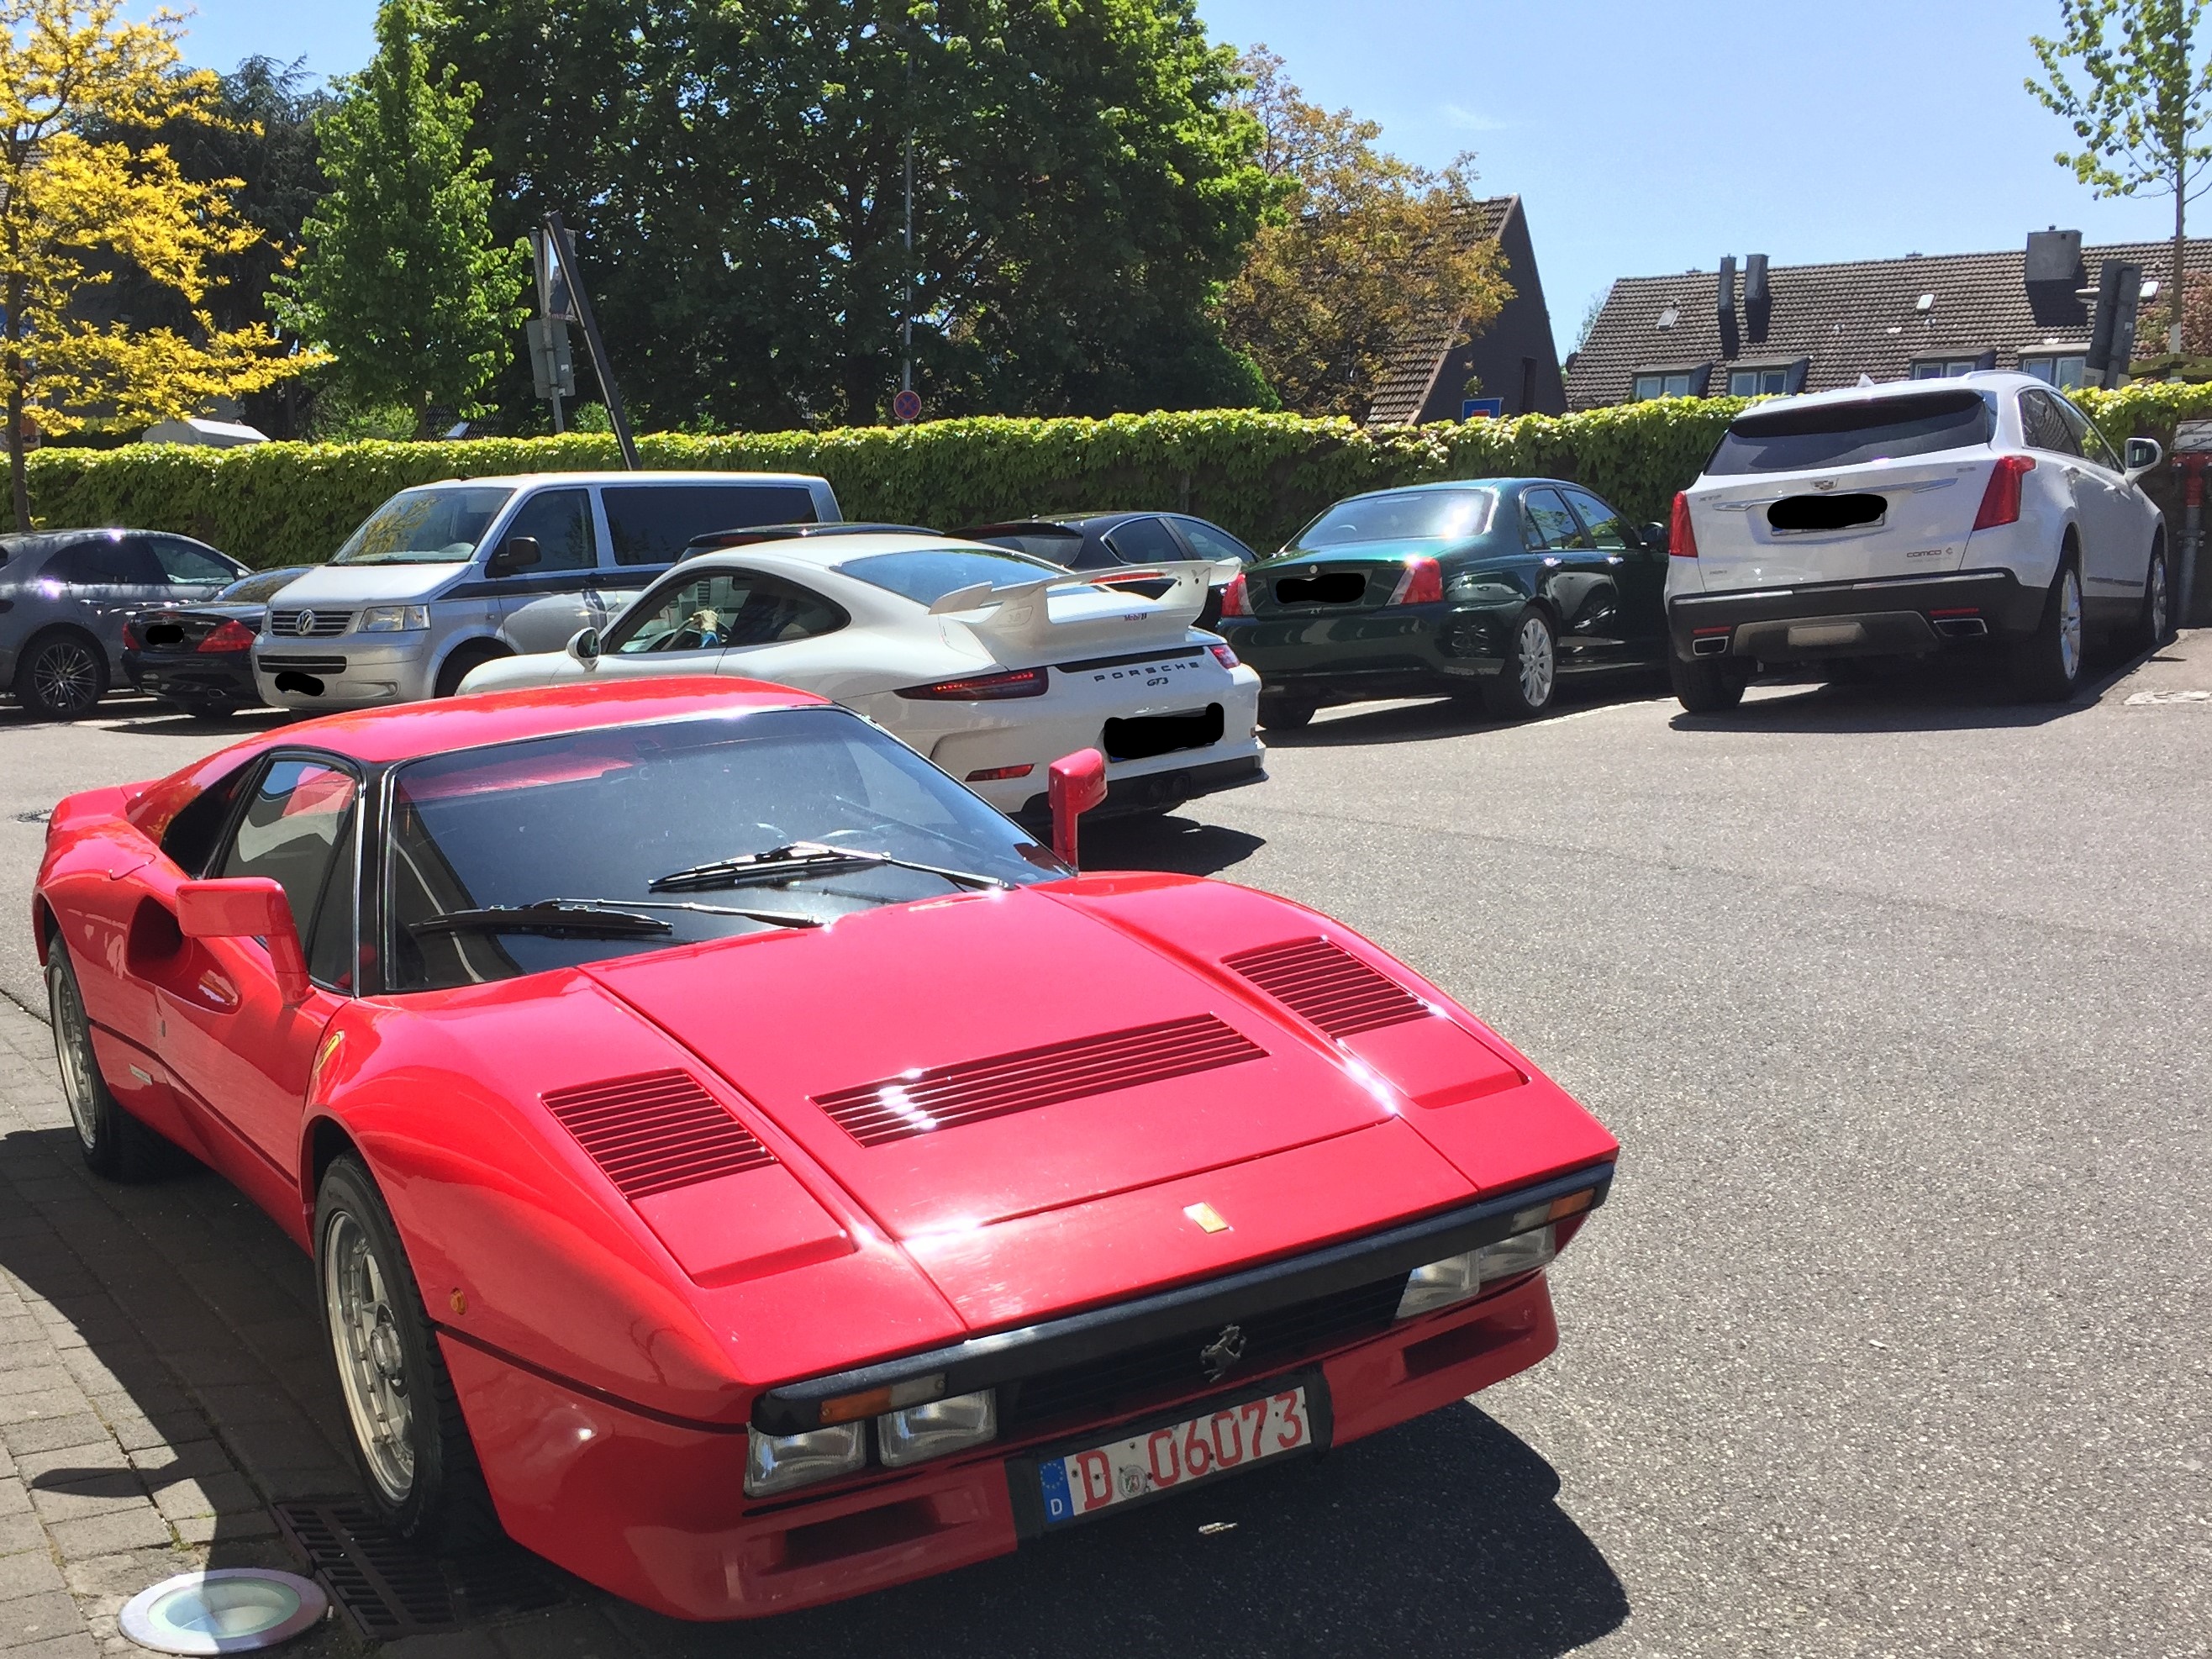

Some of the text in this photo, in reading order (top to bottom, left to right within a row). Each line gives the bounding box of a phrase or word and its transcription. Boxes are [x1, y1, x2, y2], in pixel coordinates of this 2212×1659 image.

[1093, 661, 1200, 682] PORSCHE
[1146, 677, 1169, 687] GT3
[1075, 1389, 1303, 1510] D 06073
[1050, 1498, 1063, 1516] D
